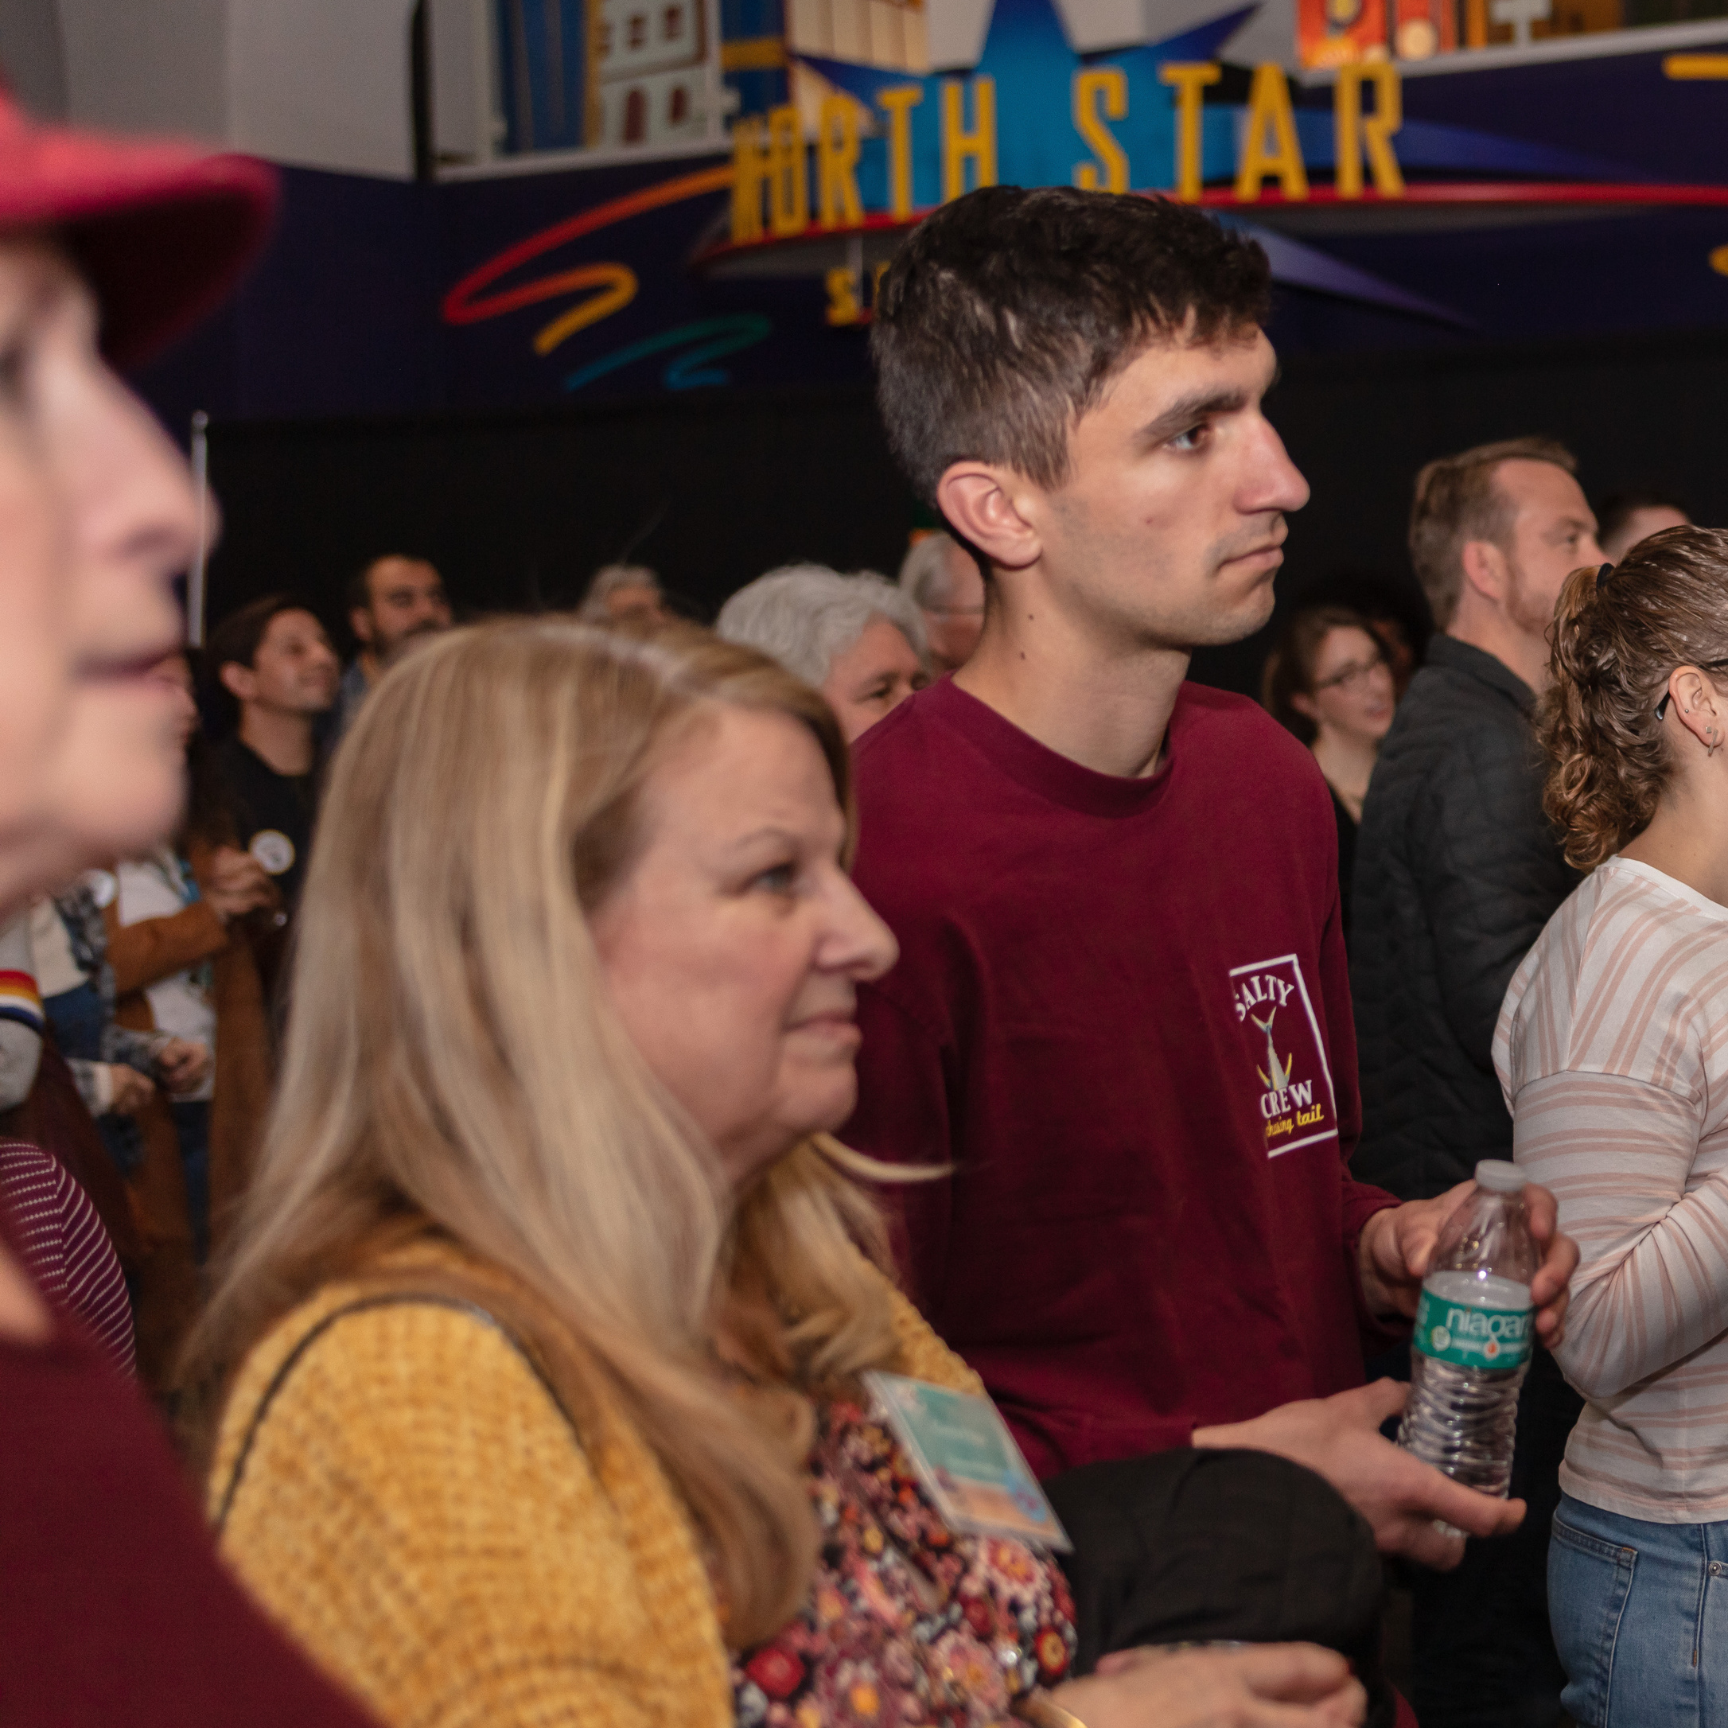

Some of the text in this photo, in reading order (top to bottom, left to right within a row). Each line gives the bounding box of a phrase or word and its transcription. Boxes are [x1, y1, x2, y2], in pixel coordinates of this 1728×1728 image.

[731, 60, 1406, 246] NORTH STAR
[1235, 974, 1295, 1022] SALTY
[1260, 1079, 1313, 1119] CREW
[1297, 1103, 1325, 1126] tail
